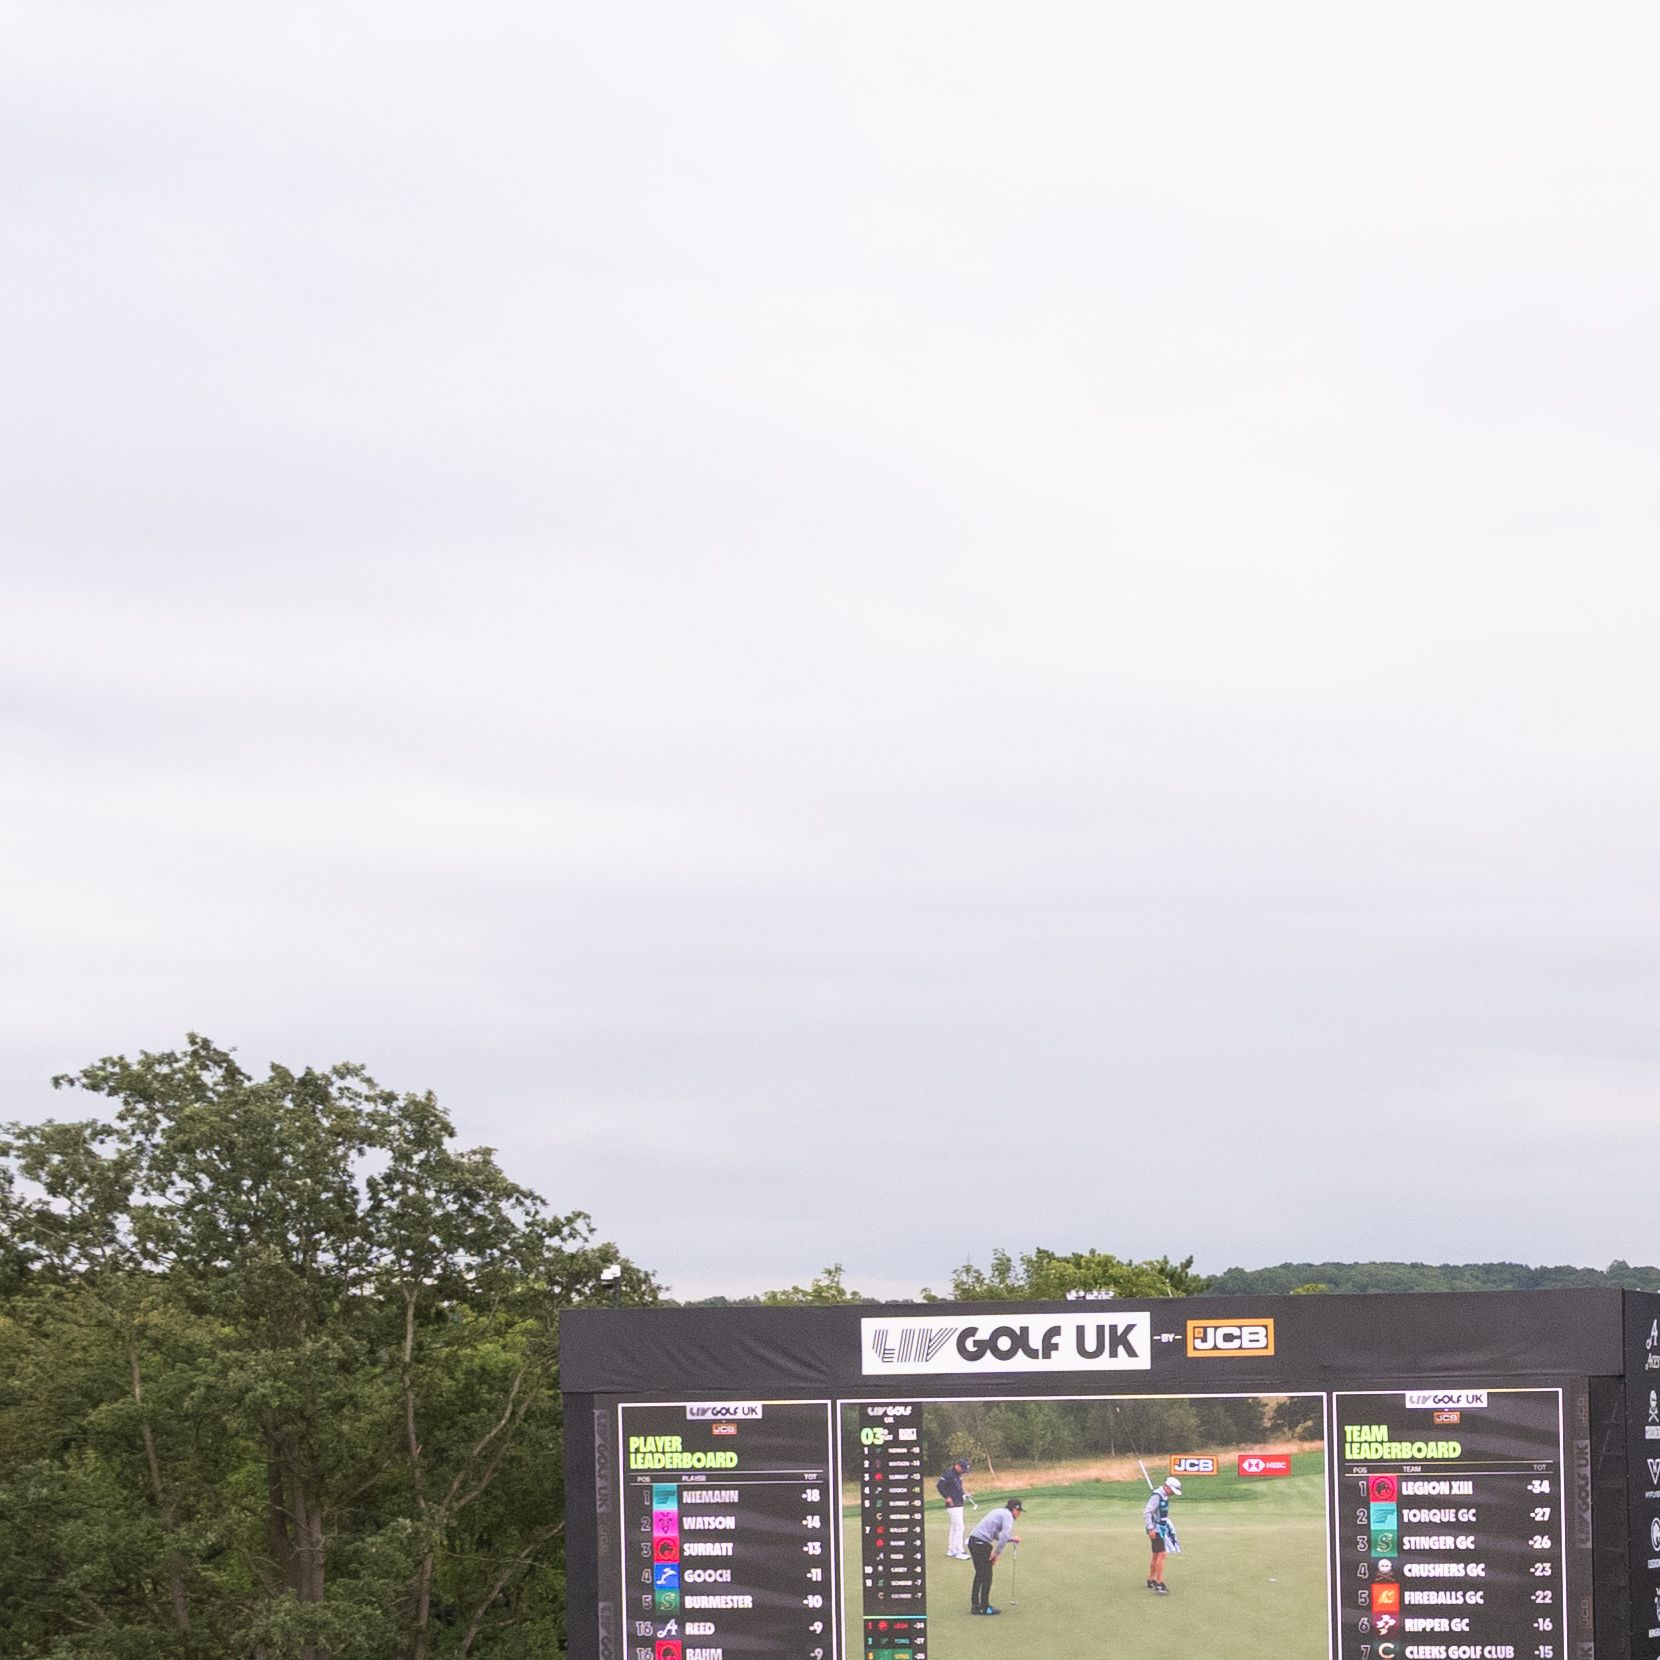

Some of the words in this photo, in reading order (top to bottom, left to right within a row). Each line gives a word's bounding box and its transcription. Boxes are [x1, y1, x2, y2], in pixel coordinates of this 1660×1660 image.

[956, 1325, 1061, 1361] GOLF
[1075, 1323, 1140, 1359] UK
[1193, 1326, 1267, 1350] JCB
[1432, 1394, 1461, 1404] GOLF
[1466, 1394, 1484, 1404] UK
[711, 1406, 738, 1416] GOLF
[742, 1406, 758, 1416] UK
[1344, 1425, 1388, 1442] TEAM
[630, 1435, 682, 1453] PLAYER
[1344, 1441, 1462, 1460] LEADERBOARD
[630, 1451, 738, 1470] LEADERBOARD
[1174, 1459, 1214, 1472] JCB
[1403, 1465, 1421, 1473] TEAM
[1359, 1481, 1367, 1496] 1
[1401, 1481, 1447, 1495] LEGION
[1452, 1481, 1473, 1495] XIII
[1527, 1480, 1550, 1495] -34
[643, 1490, 651, 1504] 1
[682, 1489, 739, 1503] NIEMANN
[801, 1489, 820, 1503] -18
[641, 1517, 651, 1531] 2
[682, 1516, 736, 1530] WATSON
[802, 1515, 821, 1530] -14
[1357, 1509, 1367, 1523] 2
[1402, 1509, 1454, 1524] TORQUE
[1457, 1509, 1476, 1523] GC
[1530, 1508, 1551, 1522] -27
[641, 1543, 652, 1557] 3
[683, 1542, 733, 1556] SURRATT
[802, 1542, 822, 1556] -13
[1357, 1536, 1368, 1551] 3
[1403, 1536, 1453, 1550] STINGER
[1456, 1536, 1475, 1549] GC
[1530, 1535, 1552, 1549] -26
[641, 1570, 652, 1584] 4
[684, 1569, 732, 1583] GOOCH
[806, 1569, 822, 1583] -11
[1357, 1564, 1368, 1578] 4
[1403, 1563, 1466, 1577] CRUSHERS
[1467, 1563, 1486, 1577] GC
[1530, 1563, 1552, 1577] -23
[642, 1596, 652, 1610] 5
[684, 1595, 753, 1609] BURMESTER
[803, 1595, 823, 1609] -10
[1358, 1591, 1369, 1606] 5
[1404, 1591, 1464, 1605] FIREBALLS
[1465, 1590, 1484, 1604] GC
[1530, 1590, 1553, 1604] -22
[636, 1622, 653, 1636] T6
[685, 1621, 715, 1636] REED
[809, 1621, 823, 1635] -9
[1358, 1618, 1369, 1633] 6
[1405, 1618, 1448, 1632] RIPPER
[1450, 1618, 1470, 1632] GC
[1532, 1617, 1553, 1632] -16
[1360, 1645, 1371, 1660] 7
[1405, 1645, 1444, 1660] CLEEKS
[1446, 1645, 1481, 1660] GOLF
[1483, 1645, 1515, 1659] CLUB
[1534, 1645, 1554, 1659] -15
